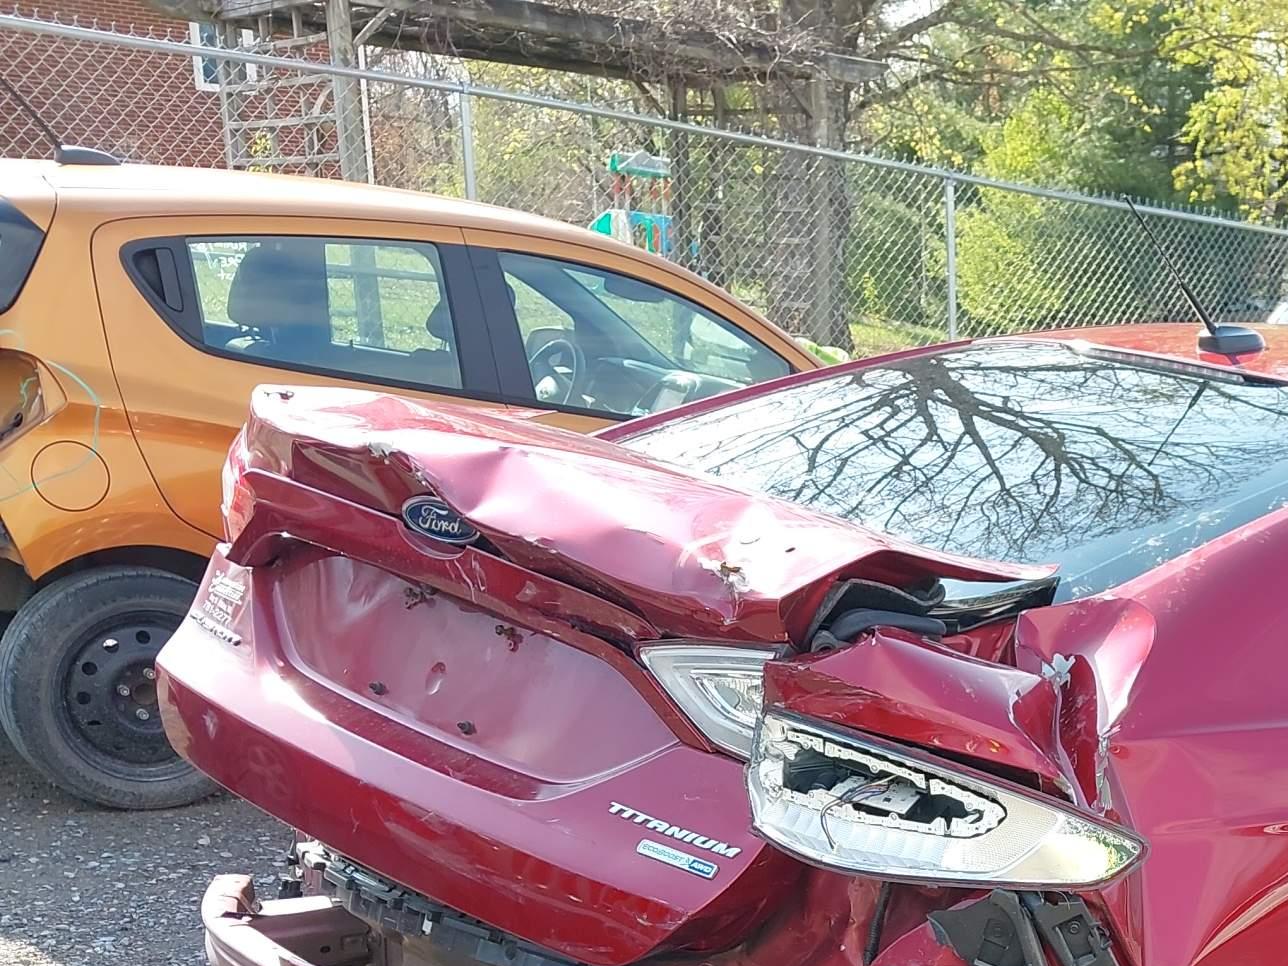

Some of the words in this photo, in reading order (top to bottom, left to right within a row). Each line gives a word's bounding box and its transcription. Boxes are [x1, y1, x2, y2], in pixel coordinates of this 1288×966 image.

[419, 505, 462, 534] Ford
[608, 801, 743, 858] TITANIUM
[690, 860, 713, 875] AWD
